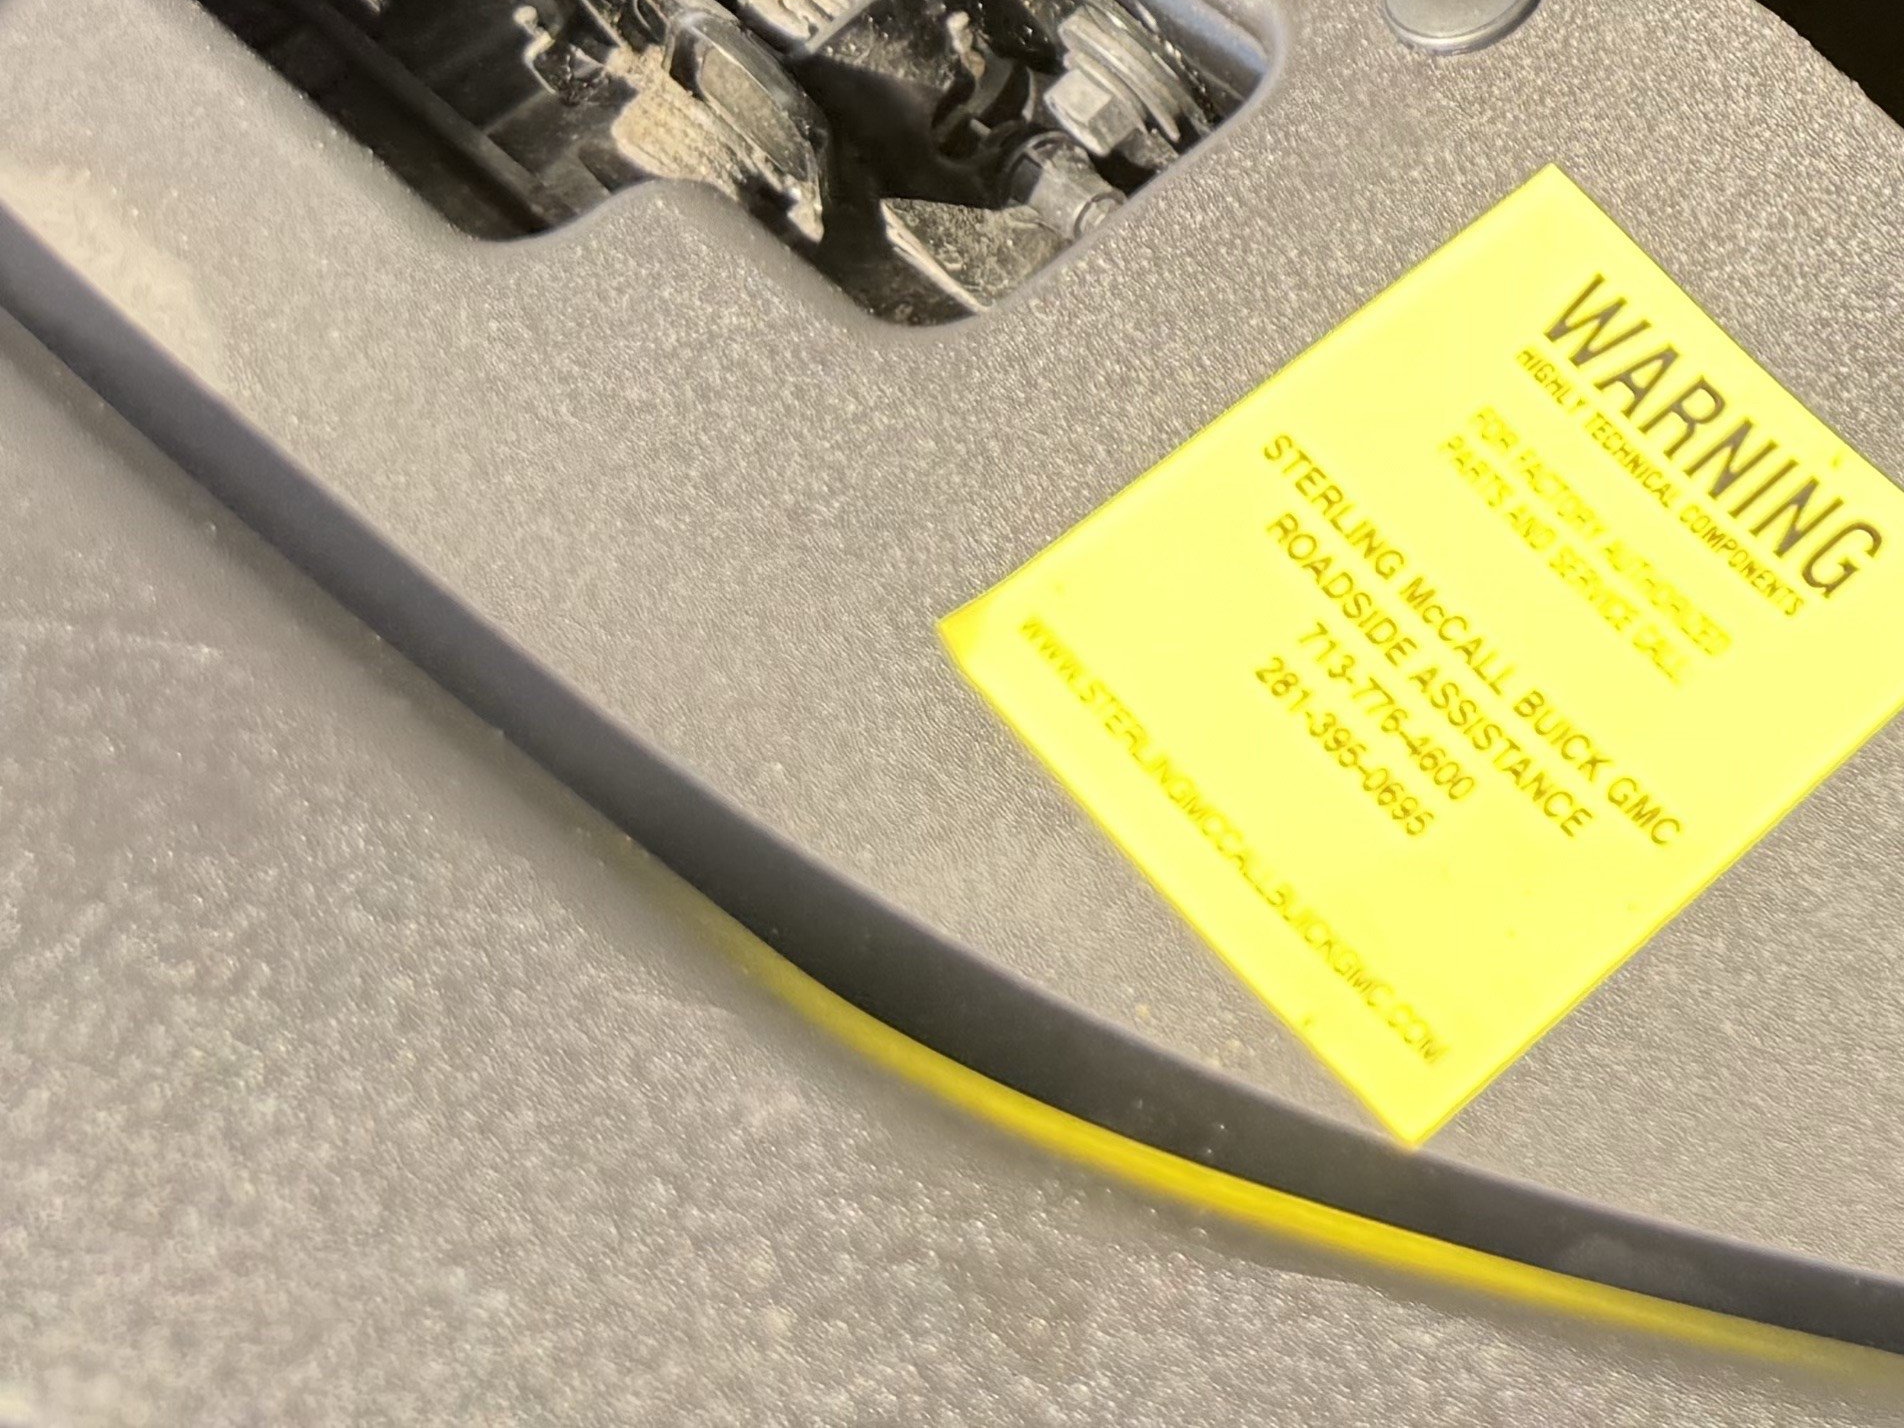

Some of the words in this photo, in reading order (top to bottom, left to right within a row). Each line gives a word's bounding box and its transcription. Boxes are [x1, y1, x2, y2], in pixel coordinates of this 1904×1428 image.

[1512, 345, 1588, 415] HIGHLY
[1580, 410, 1685, 508] TECHNICAL
[1677, 499, 1808, 621] COMPONENTS
[1530, 271, 1891, 604] WARNING
[1252, 654, 1436, 841] 281-395-0695
[1257, 431, 1413, 582] STERLING
[1396, 573, 1526, 698] McCALL
[1511, 685, 1616, 787] BUICK
[1602, 772, 1684, 851] GMC
[1262, 510, 1422, 667] ROADSIDE
[1407, 655, 1595, 843] ASSISTANCE
[1294, 620, 1478, 805] 713-776-4600
